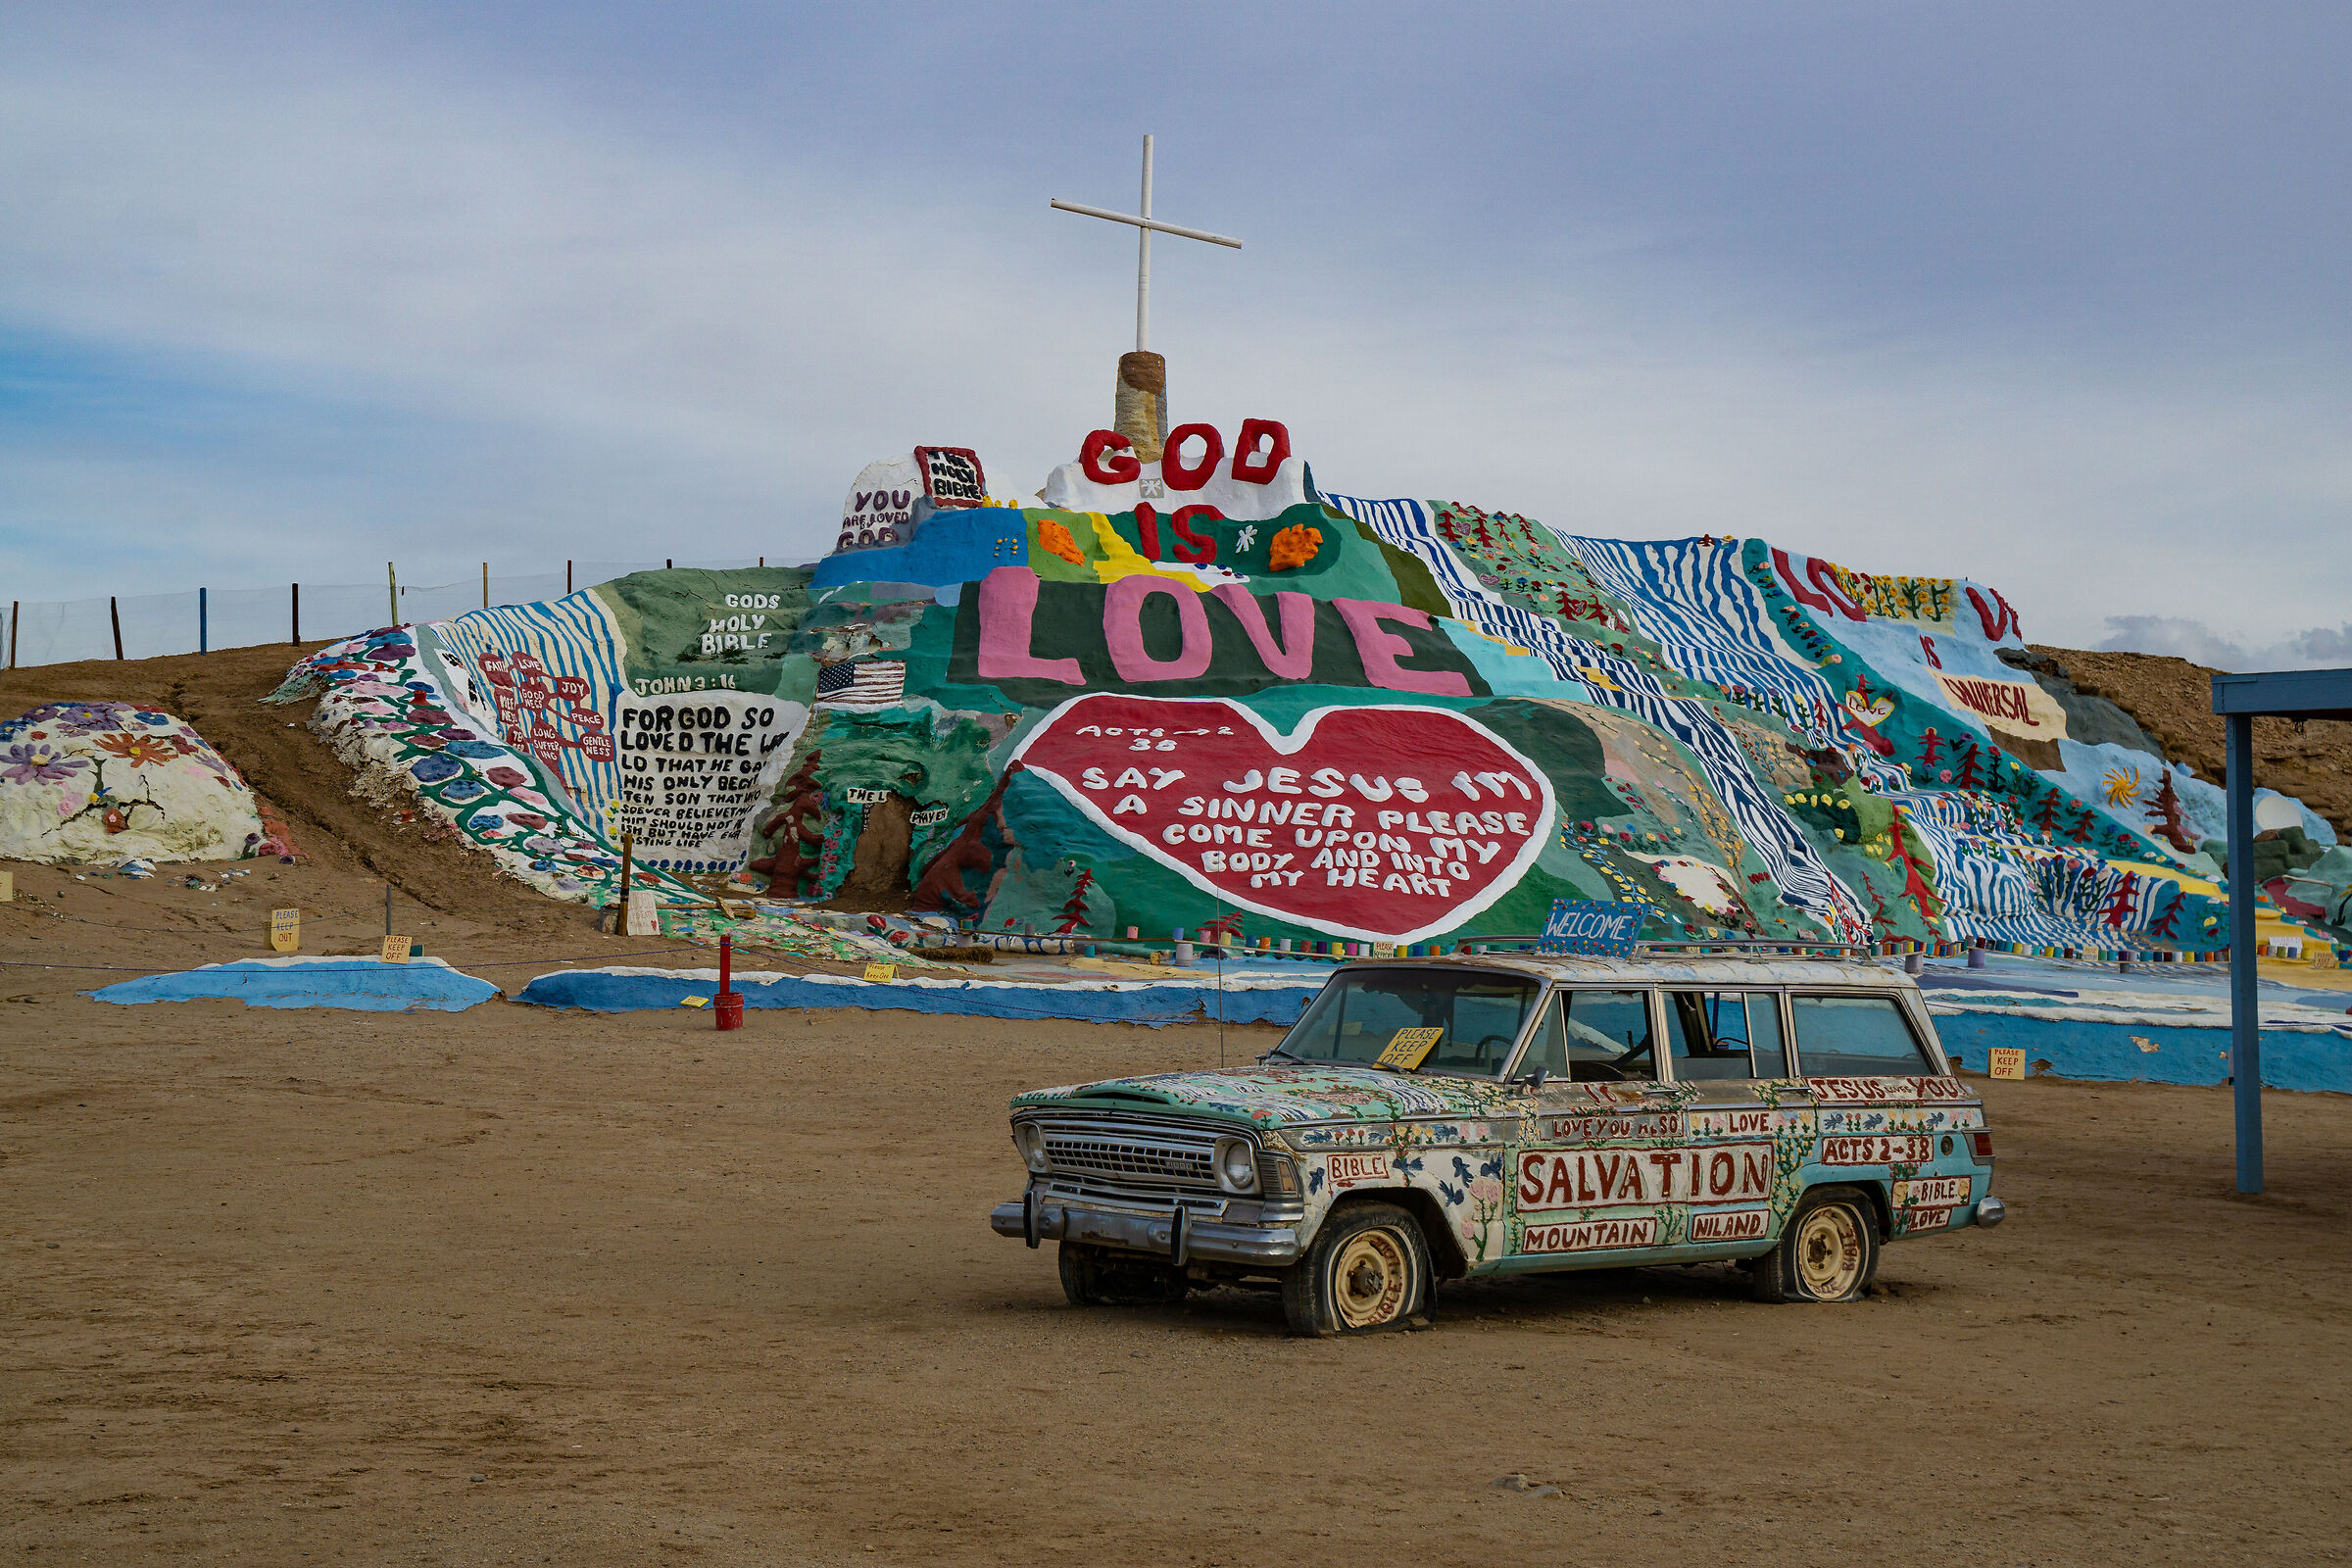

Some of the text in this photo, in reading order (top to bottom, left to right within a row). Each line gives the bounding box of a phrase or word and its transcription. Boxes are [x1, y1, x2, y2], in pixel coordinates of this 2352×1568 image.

[1079, 417, 1291, 491] GOD
[931, 463, 975, 484] HOLY
[934, 477, 982, 500] BIBLE
[855, 490, 910, 512] YOU
[842, 511, 909, 529] ARE LOVED
[838, 527, 899, 549] GOD
[1135, 502, 1225, 564] IS
[725, 594, 780, 610] GODS
[709, 613, 765, 633] HOLY
[978, 565, 1473, 697] LOVE
[701, 632, 772, 655] BIBLE
[1919, 634, 1942, 670] IS
[522, 688, 545, 701] GOOD
[562, 681, 585, 697] JOY
[635, 675, 691, 696] JOHN
[524, 699, 543, 709] NESS
[1848, 695, 1886, 716] LOVE
[1942, 677, 2040, 727] UNIVERSAL
[570, 712, 602, 725] PEACE
[622, 705, 775, 732] FOR GOD SO
[533, 728, 556, 739] LONG
[1217, 725, 1235, 736] 2
[533, 739, 561, 752] SUFFER
[582, 736, 612, 748] GENTLE
[620, 730, 694, 752] LOVED
[700, 732, 753, 756] THE
[540, 751, 558, 760] ING
[586, 746, 611, 757] NESS
[621, 754, 648, 771] LD
[656, 758, 706, 772] THAT
[710, 759, 733, 771] HE
[623, 774, 655, 791] HIS
[662, 774, 713, 791] ONLY
[1082, 766, 1187, 791] SAY
[1222, 766, 1430, 804] JESUS
[622, 790, 655, 806] TEN
[664, 792, 701, 805] SON
[707, 793, 743, 805] THAT
[849, 788, 875, 802] THE
[620, 804, 670, 818] SOEVER
[911, 809, 947, 824] PRAYER
[1112, 794, 1532, 837] A SINNER PLEASE
[620, 816, 647, 825] HIM
[650, 818, 704, 831] SHOULD
[706, 820, 732, 831] NOT
[648, 827, 677, 838] BUT
[681, 830, 714, 840] HAVE
[676, 838, 703, 848] LIFE
[1162, 823, 1501, 865] COME UPON MY
[1201, 847, 1472, 881] BODY AND INTO
[1250, 867, 1451, 898] MY HEART
[275, 909, 299, 919] PLEASE
[276, 922, 294, 931] KEEP
[1546, 911, 1633, 941] WELCOME
[278, 932, 293, 943] OUT
[1397, 1028, 1440, 1040] PLEASE
[1391, 1040, 1428, 1053] KEEP
[1381, 1054, 1413, 1065] OFF
[1996, 1056, 2019, 1065] KEEP
[1994, 1066, 2014, 1076] OFF
[1811, 1079, 1886, 1099] JESUS
[1553, 1117, 1593, 1139] LOVE
[1592, 1118, 1631, 1136] YOU
[1824, 1136, 1875, 1160] ACTS
[1331, 1156, 1385, 1179] BIBLE
[1521, 1152, 1768, 1203] SALVATION
[1695, 1214, 1765, 1237] NILAND.
[1526, 1222, 1648, 1250] MOUNTAIN
